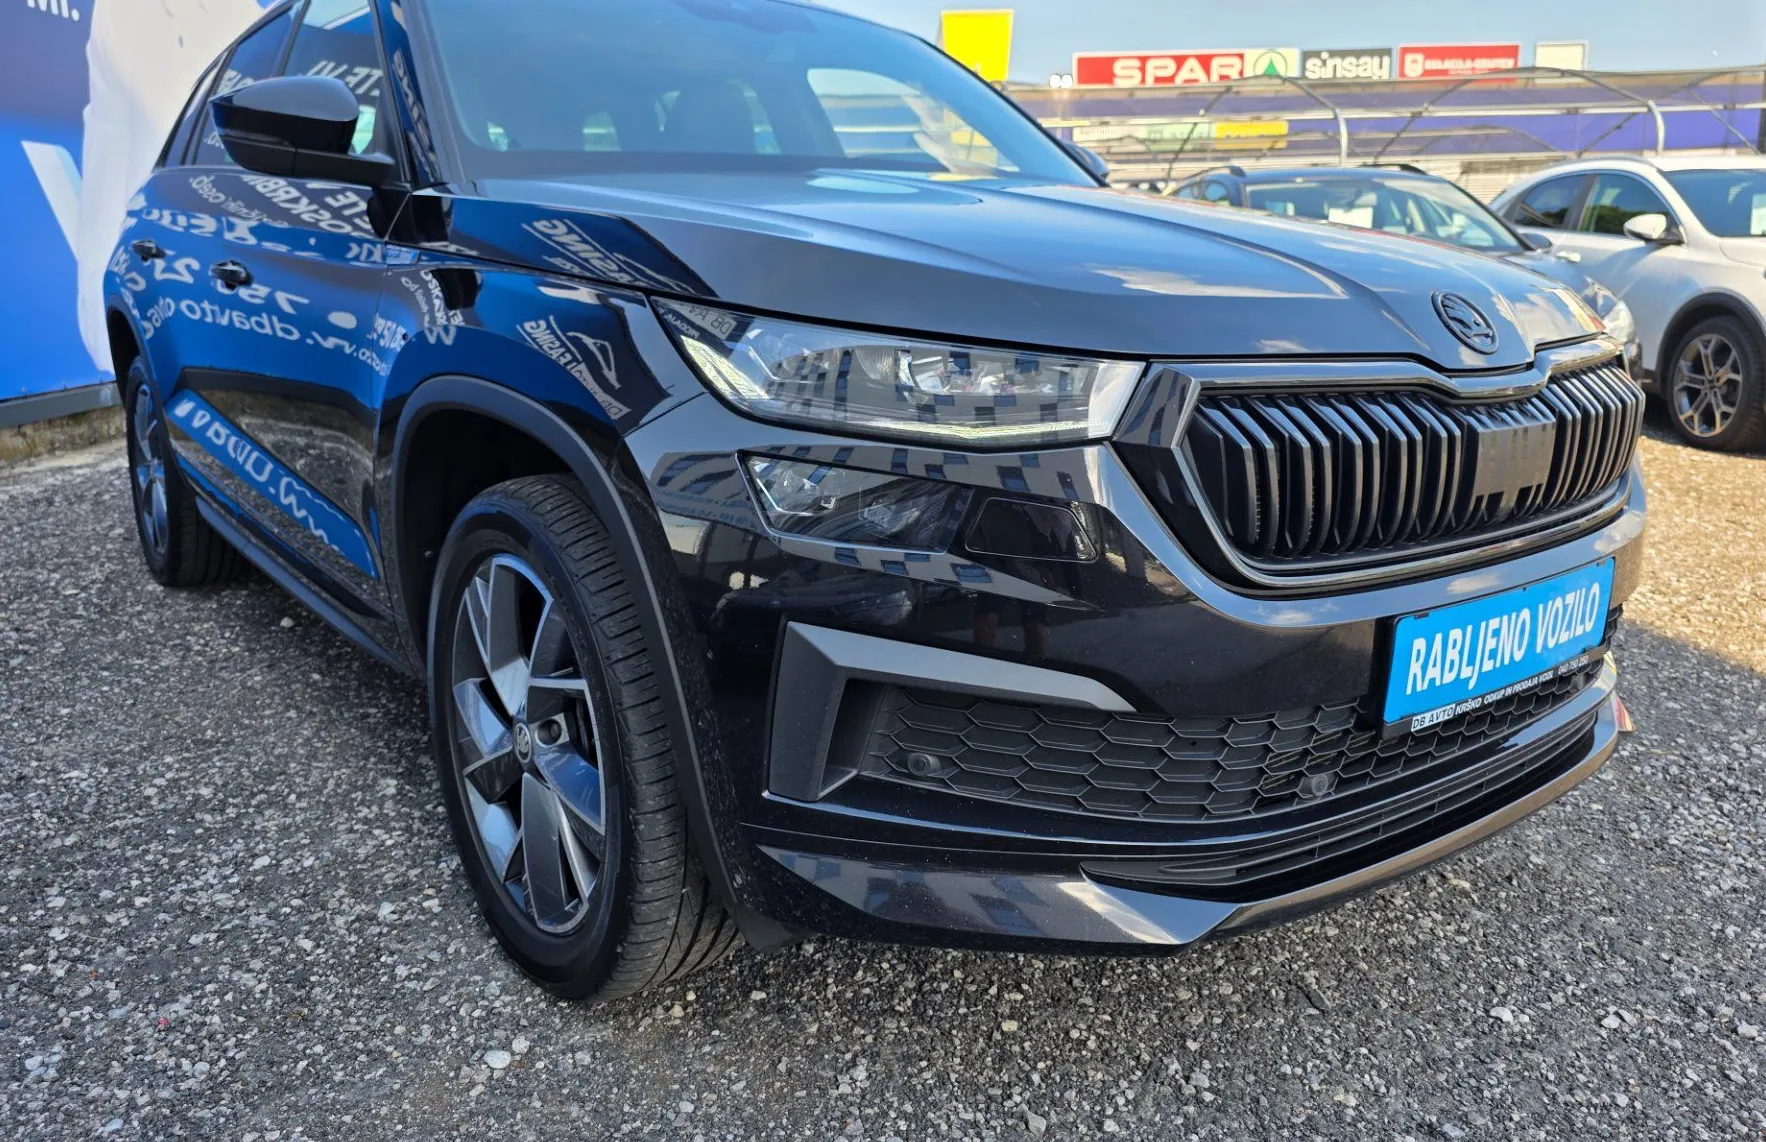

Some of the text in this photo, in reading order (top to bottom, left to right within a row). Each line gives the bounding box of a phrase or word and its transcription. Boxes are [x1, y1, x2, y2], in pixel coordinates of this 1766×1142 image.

[1112, 55, 1244, 86] SPAR
[1304, 52, 1390, 80] sinsay
[1405, 582, 1600, 696] RABLJENO VOZILO
[1412, 716, 1426, 729] DB
[1428, 705, 1454, 724] AVTO
